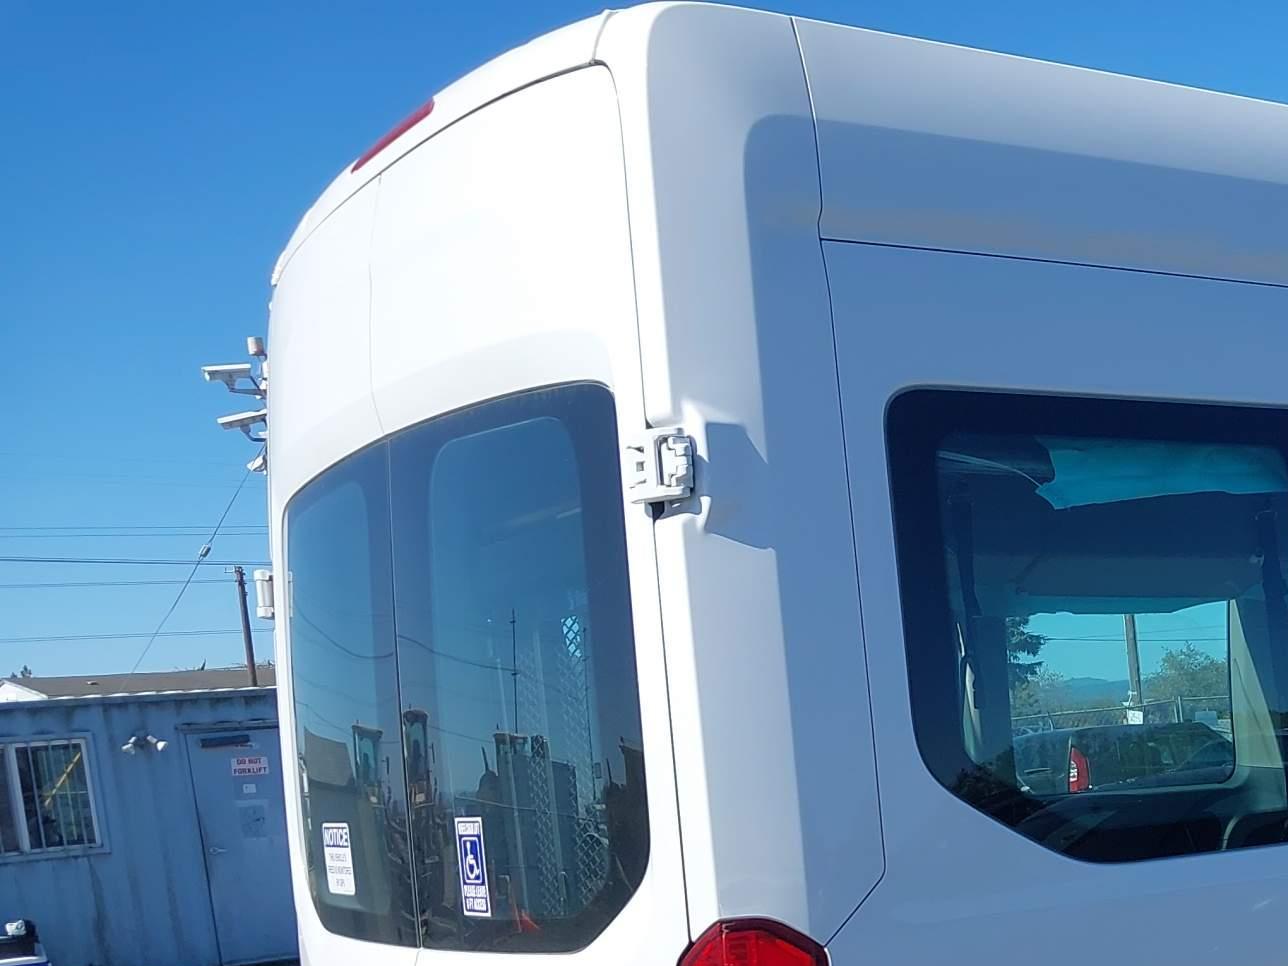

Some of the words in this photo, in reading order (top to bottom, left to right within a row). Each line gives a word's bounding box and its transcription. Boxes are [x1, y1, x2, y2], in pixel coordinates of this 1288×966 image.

[248, 757, 262, 765] NOT
[233, 766, 268, 775] FORKLIFT
[323, 829, 349, 846] NOTICE
